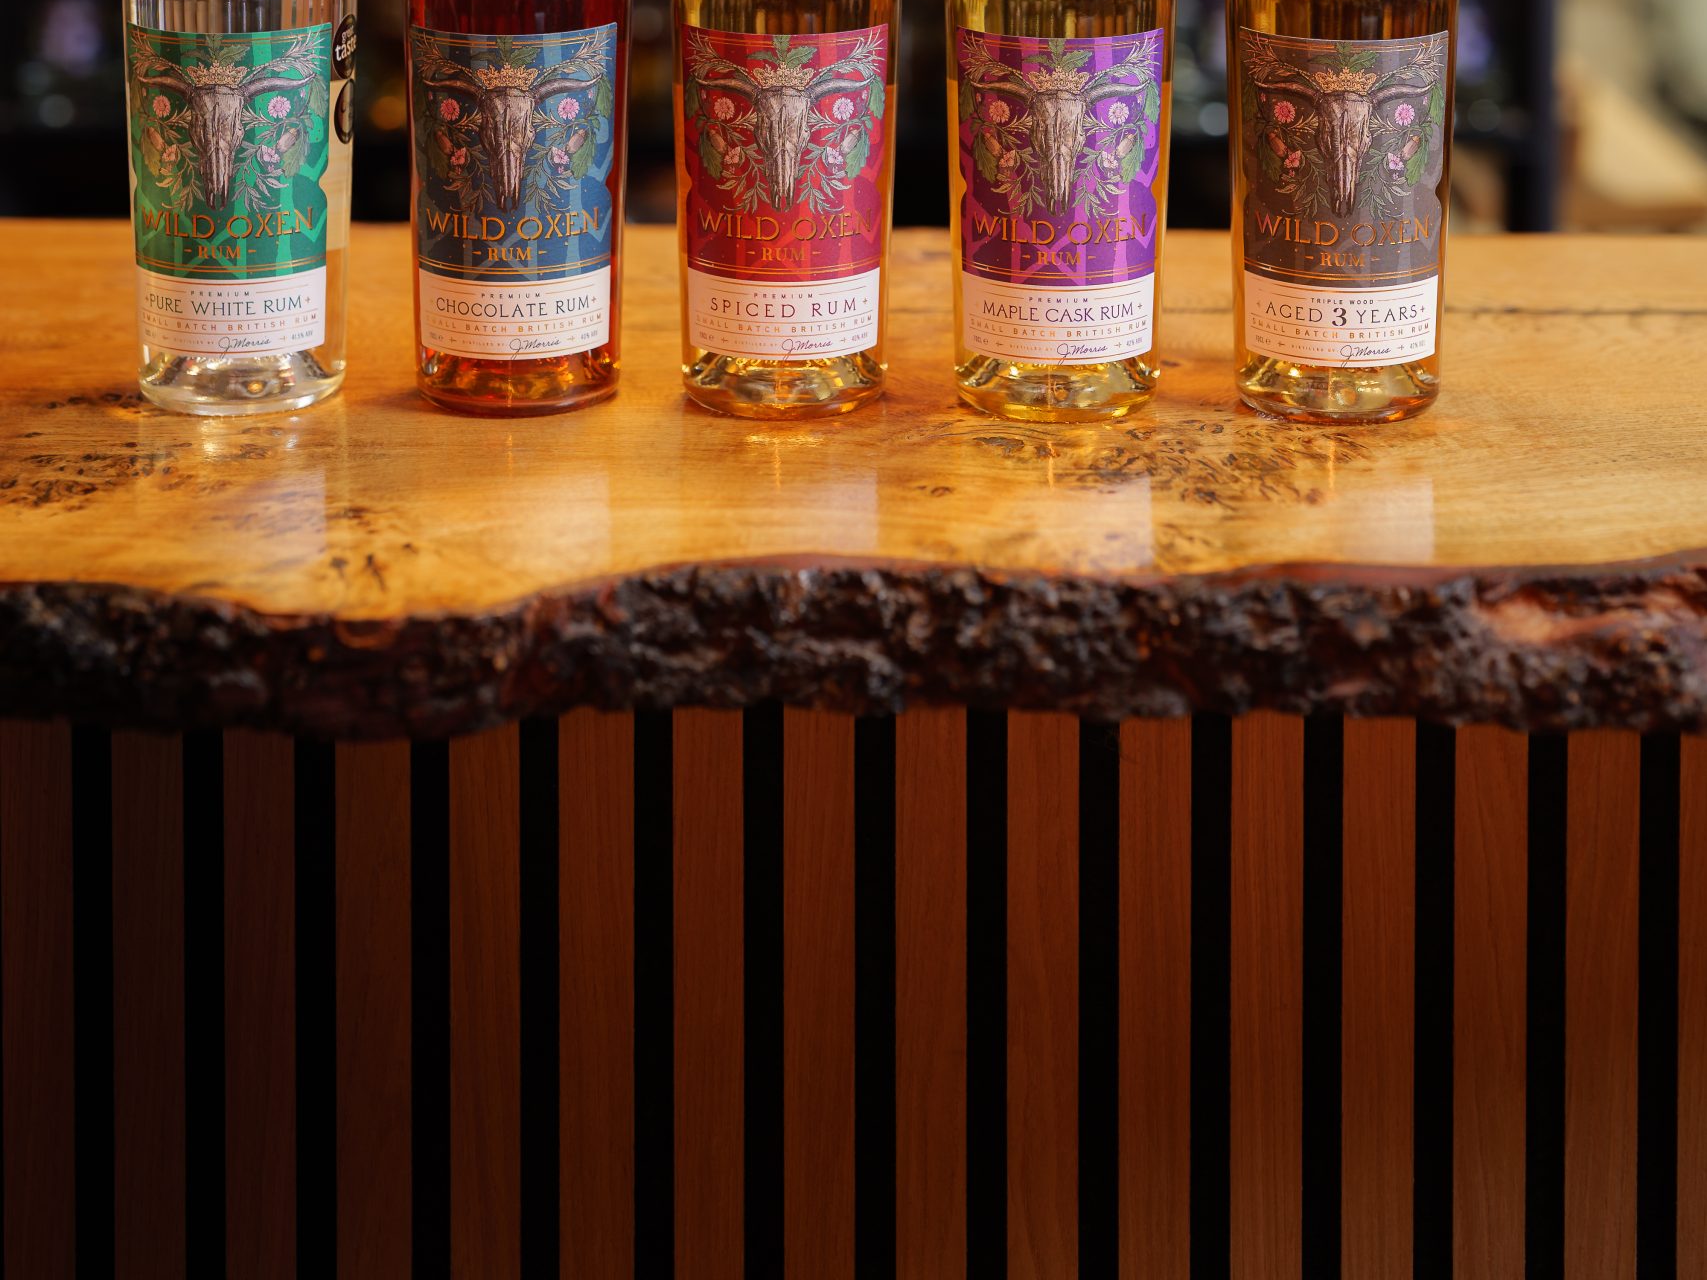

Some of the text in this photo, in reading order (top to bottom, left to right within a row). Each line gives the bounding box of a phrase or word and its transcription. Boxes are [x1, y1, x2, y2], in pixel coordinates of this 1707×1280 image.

[142, 207, 313, 239] WILD OXEN
[426, 207, 599, 241] WILD OXEN
[699, 207, 871, 241] WILD OXEN
[973, 212, 1146, 245] WILD OXEN
[1255, 210, 1429, 246] WILD OXEN
[198, 246, 241, 259] RUM
[488, 247, 532, 261] RUM
[762, 247, 806, 261] RUM
[1037, 251, 1081, 266] RUM
[1320, 252, 1365, 267] RUM
[149, 293, 302, 316] PURE WHITE RUM
[436, 295, 590, 318] CHOCOLATE RUM
[710, 297, 857, 318] SPICED RUM
[983, 300, 1134, 322] MAPLE CASK RUM
[1311, 297, 1343, 305] TRIPLE
[177, 322, 217, 331] BATCH
[228, 320, 285, 331] BRITISH
[295, 313, 316, 322] RUM
[465, 323, 507, 333] BATCH
[518, 321, 574, 333] BRITISH
[582, 313, 602, 323] RUM
[696, 314, 873, 333] SMALL BATCH BRITISH RUM
[1265, 301, 1417, 327] AGED 3 YEARS
[971, 318, 1146, 338] SMALL BATCH BRITISH RUM
[1252, 317, 1429, 339] SMALL BATCH BRITISH RUM
